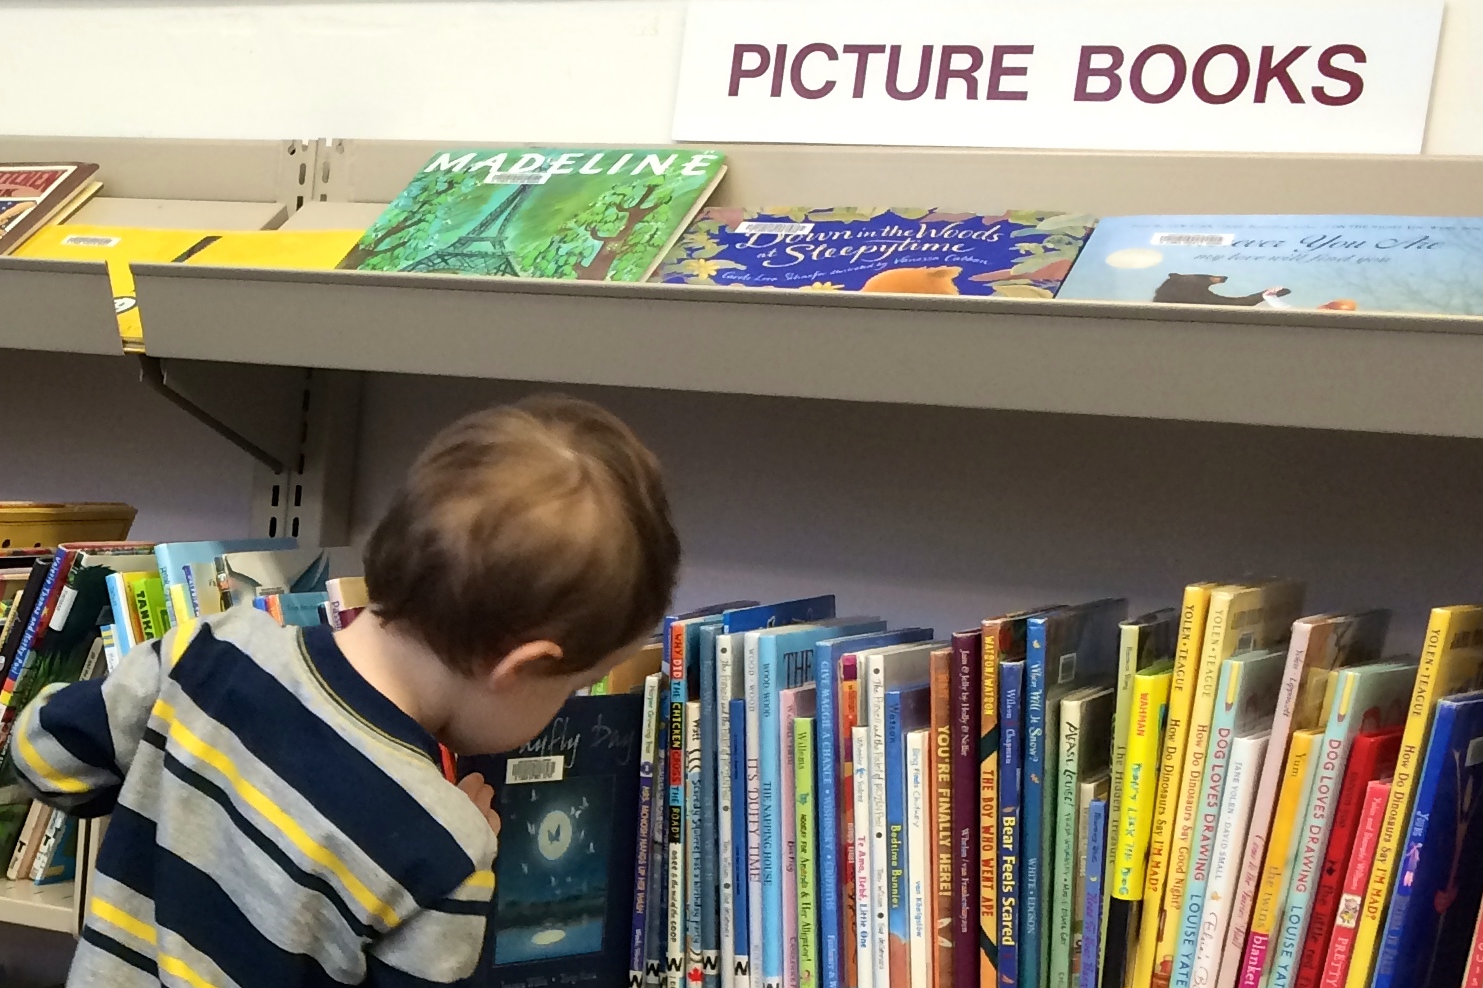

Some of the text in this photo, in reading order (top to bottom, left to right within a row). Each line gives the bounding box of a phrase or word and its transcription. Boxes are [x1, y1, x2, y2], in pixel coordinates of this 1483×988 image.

[727, 42, 1368, 107] PICTURE BOOKS
[756, 239, 976, 268] at Sleepytime
[861, 226, 877, 238] in
[880, 225, 914, 238] the
[916, 222, 1002, 243] Woods
[1293, 234, 1367, 253] You
[782, 649, 815, 688] THE
[983, 635, 995, 716] WATSON/WATSON
[1174, 604, 1194, 693] YOLEN TEAGUE
[1411, 628, 1442, 718] YOLEN TEAGUE
[670, 632, 683, 841] WHY DID THE CHICKEN CROSS THE ROAD?
[797, 731, 808, 770] Willems
[1136, 693, 1149, 737] WAHMAN
[1147, 718, 1181, 893] How Do Dinosaurs Say I'M MAD?
[1193, 727, 1229, 882] DOG LOVES DRAWING
[1289, 753, 1307, 778] Yum
[747, 758, 761, 883] IT'S DUFFY TIME!
[762, 781, 773, 886] THE NAPPING HOUSE
[937, 725, 952, 896] YOU'RE FINALLY HERE!
[981, 770, 995, 918] THE BOY WHO WENT APE
[1169, 724, 1208, 910] How Do Dinosaurs Say Good Night?
[1295, 738, 1341, 893] DOG LOVES DRAWING
[1365, 745, 1416, 920] How Do Dinosaurs Say I'M MAD?
[890, 824, 902, 909] Bedtime Bunnies
[1001, 816, 1016, 946] Bear Feels Scared
[1182, 894, 1202, 947] LOUISE
[1244, 934, 1268, 986] blanket
[1282, 905, 1303, 958] LOUISE
